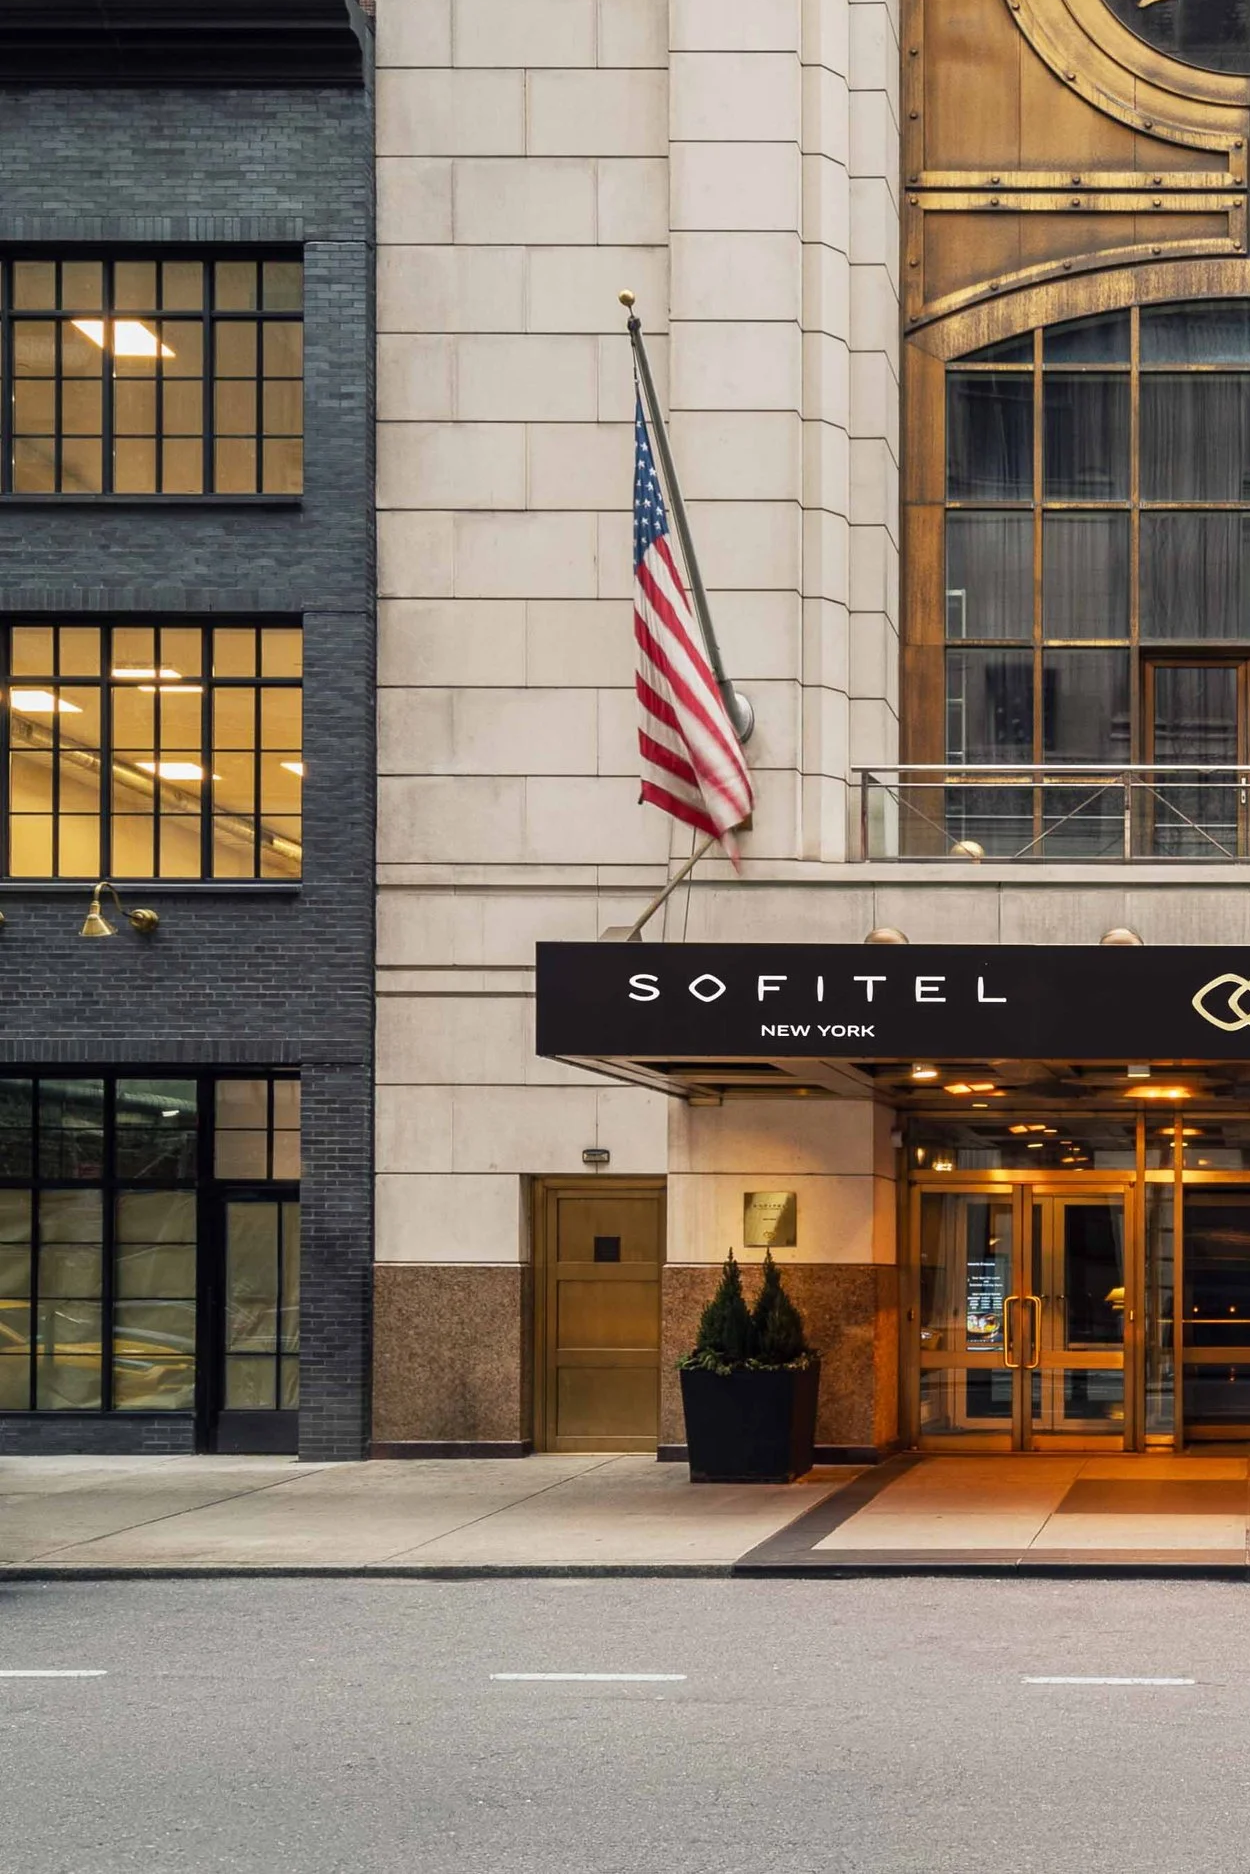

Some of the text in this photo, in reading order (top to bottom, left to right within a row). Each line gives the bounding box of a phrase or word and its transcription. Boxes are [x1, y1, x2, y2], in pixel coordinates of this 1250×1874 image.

[628, 973, 1007, 1003] SOFITEL
[761, 1024, 875, 1038] NEW YORK
